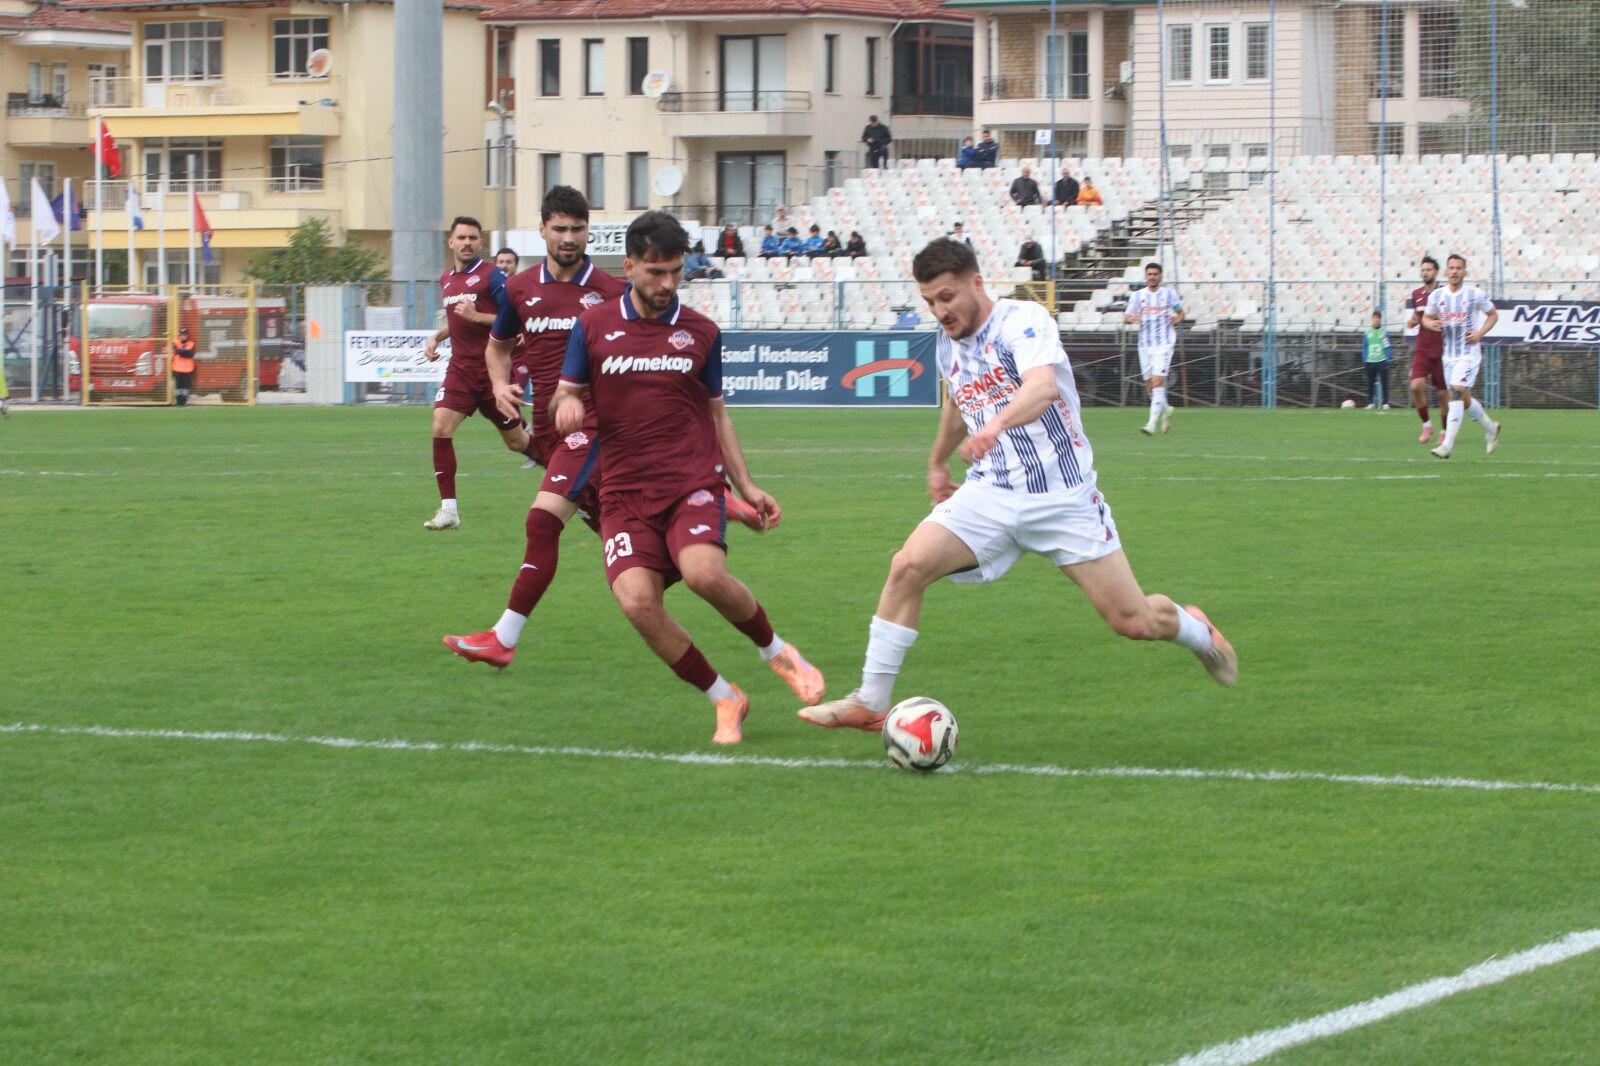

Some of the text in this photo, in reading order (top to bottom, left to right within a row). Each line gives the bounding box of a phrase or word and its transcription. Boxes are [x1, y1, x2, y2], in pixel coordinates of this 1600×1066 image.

[1513, 306, 1600, 323] MEM
[758, 346, 829, 362] Hastanesi
[632, 355, 693, 373] mekap
[786, 370, 829, 391] Diler
[605, 532, 633, 567] 23
